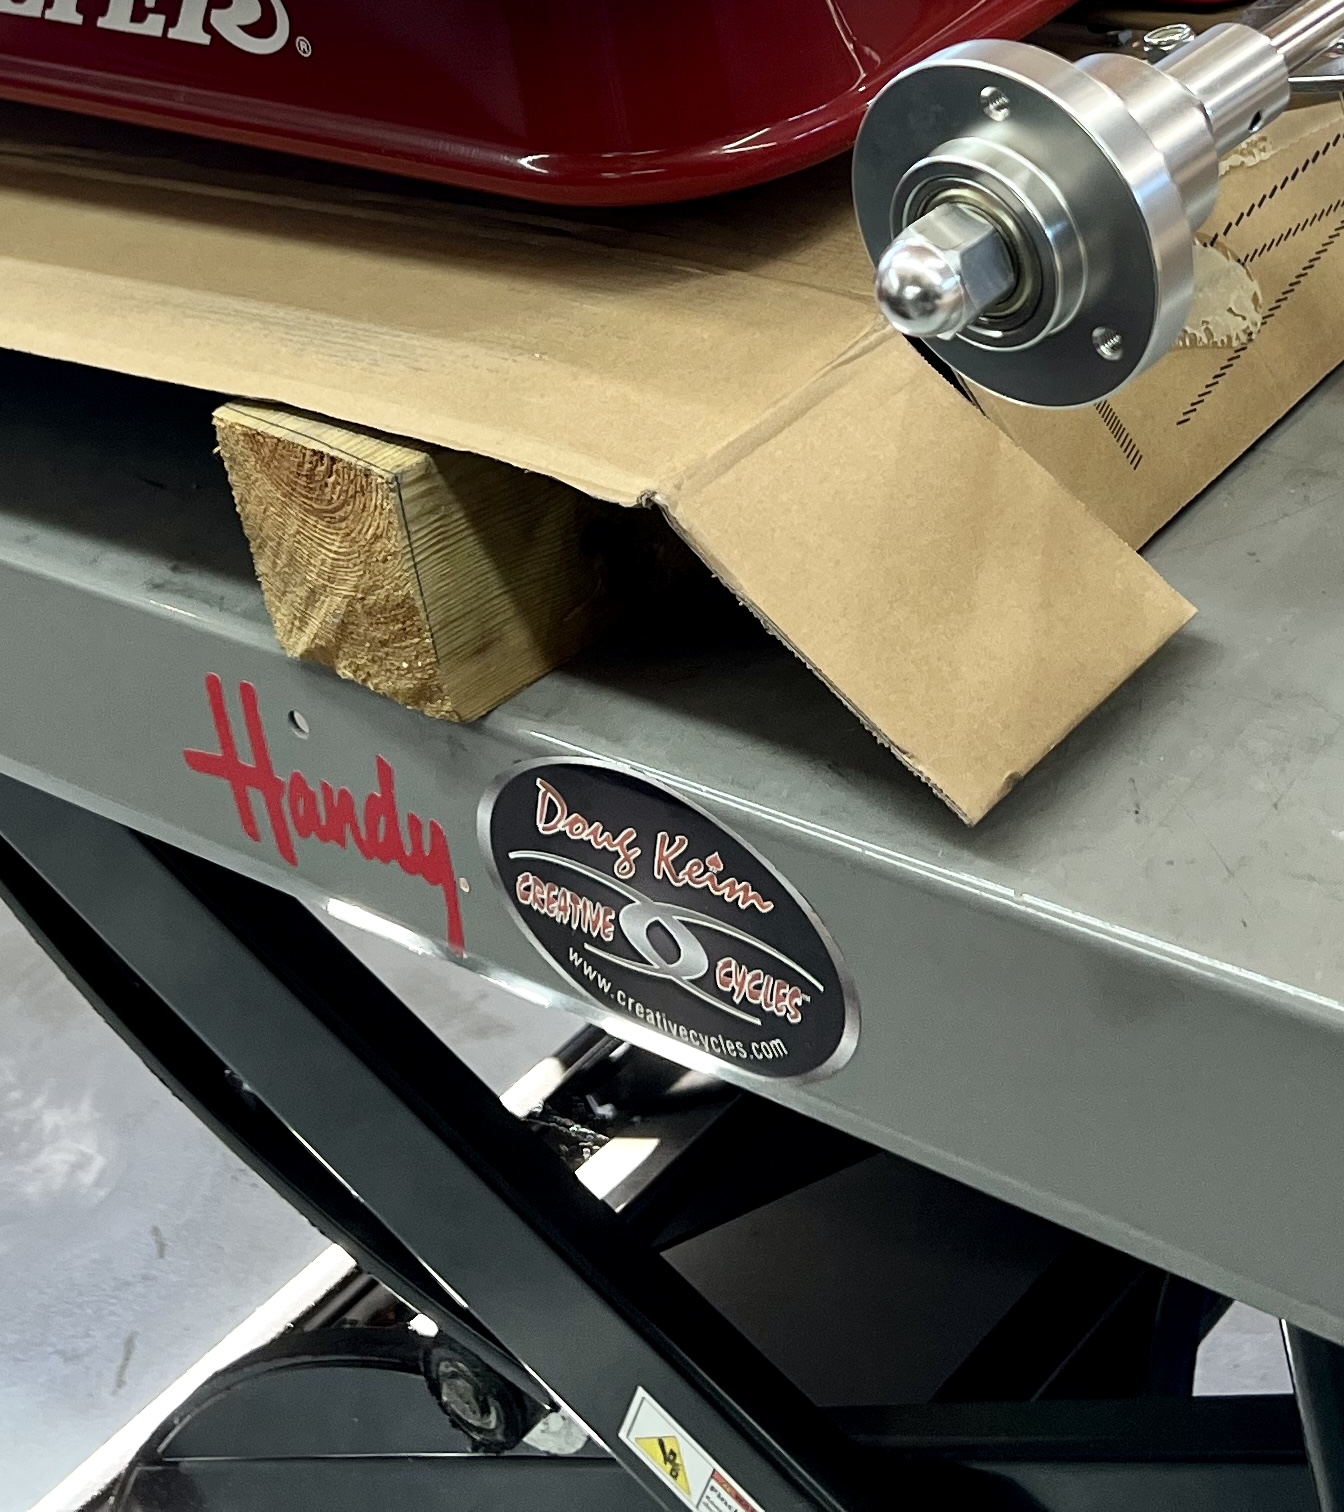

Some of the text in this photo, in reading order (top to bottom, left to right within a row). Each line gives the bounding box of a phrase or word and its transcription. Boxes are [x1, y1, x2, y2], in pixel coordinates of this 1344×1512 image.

[183, 671, 468, 958] Handy
[534, 776, 775, 914] Doug Keim
[515, 871, 617, 942] CREATIVE
[567, 945, 789, 1061] www.creativecycles.com
[714, 955, 804, 1025] CYCLES
